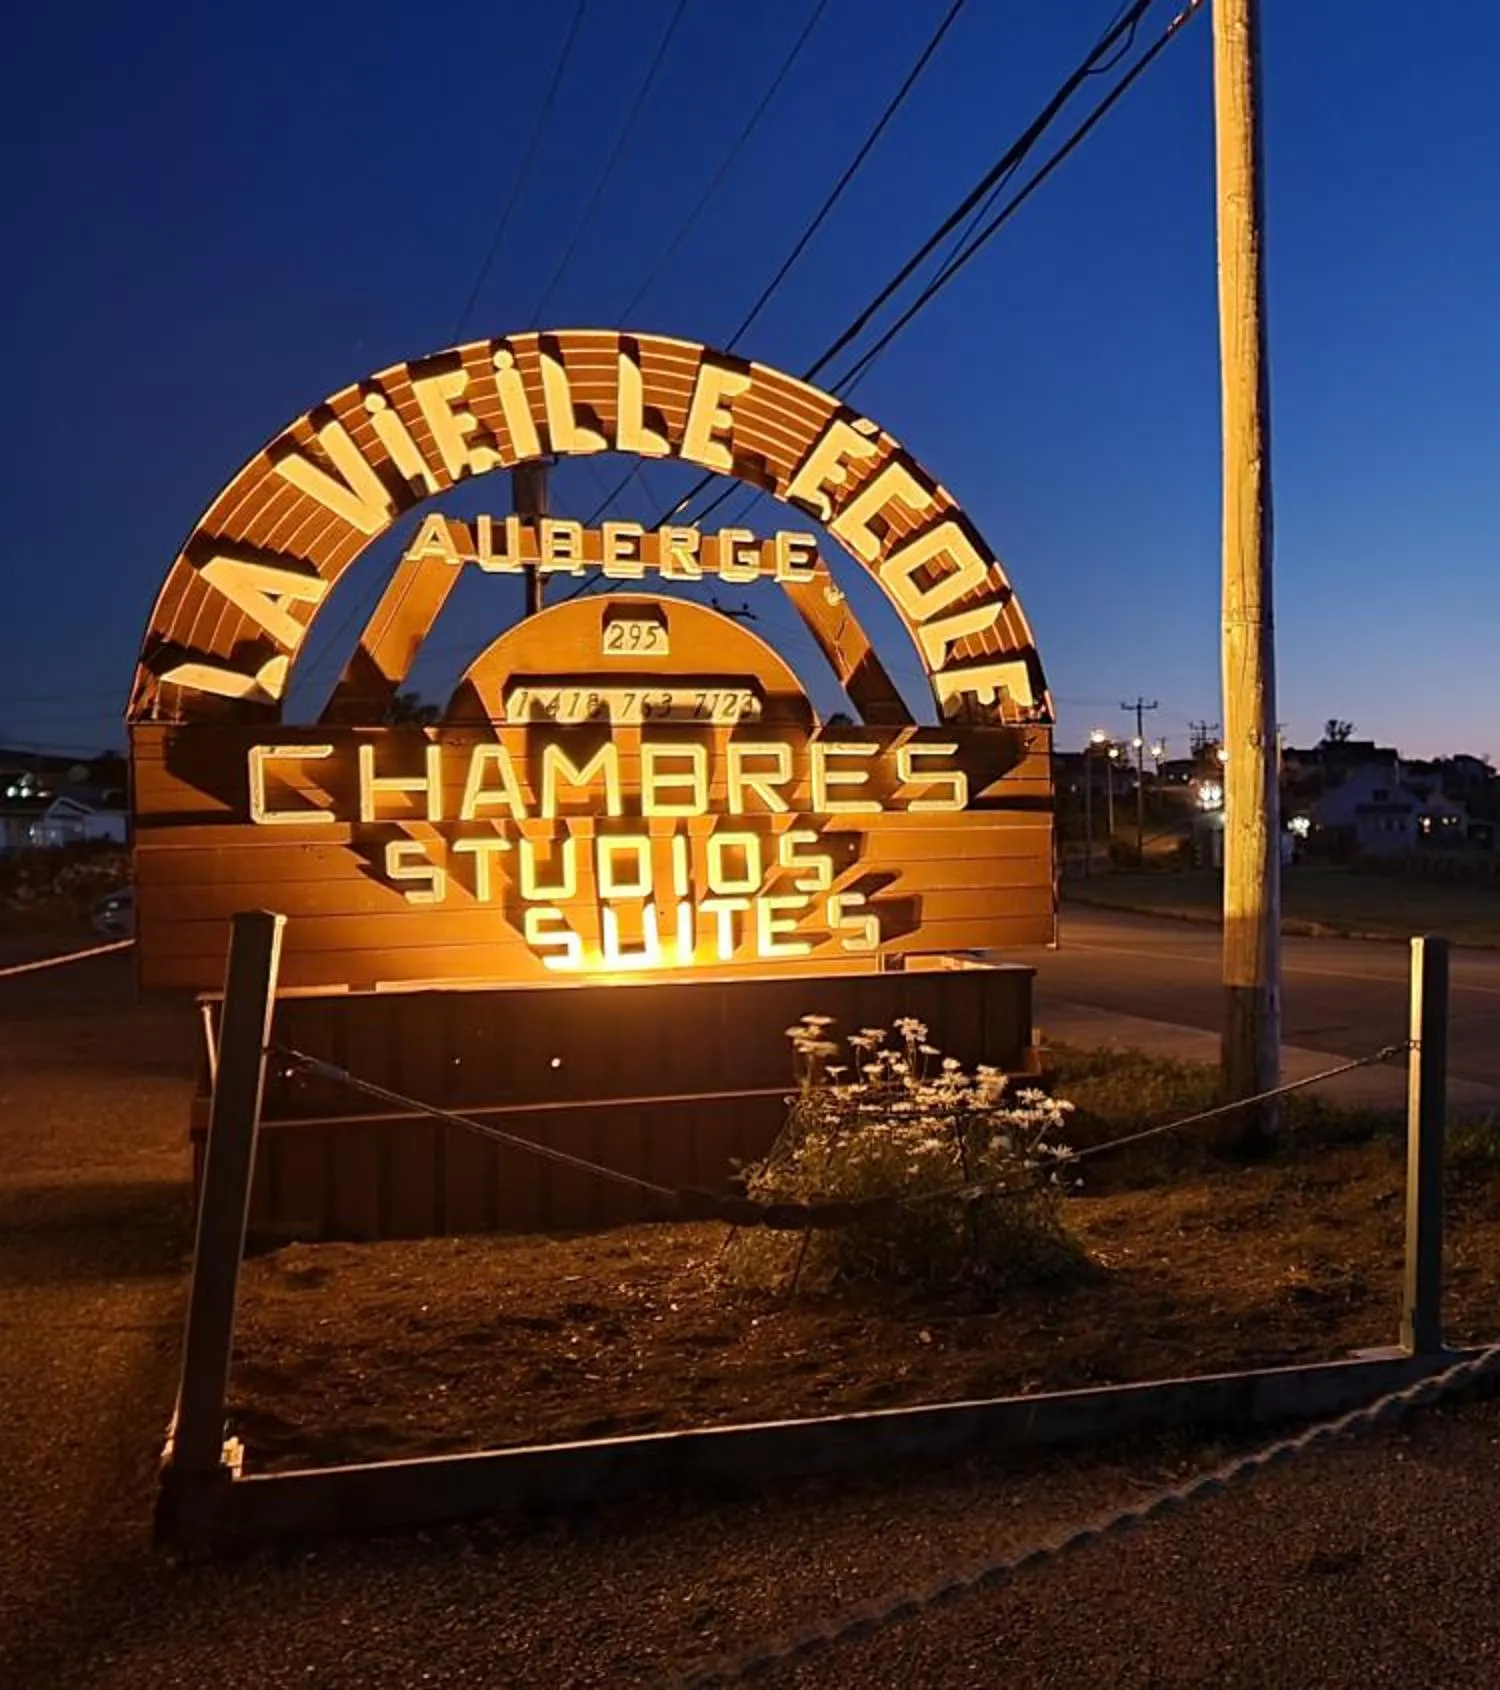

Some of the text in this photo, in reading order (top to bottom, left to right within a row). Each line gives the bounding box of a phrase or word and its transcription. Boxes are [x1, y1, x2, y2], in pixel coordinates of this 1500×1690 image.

[158, 555, 330, 701] LA
[785, 416, 1033, 716] ÉCOLE
[404, 513, 817, 584] AUBERGE
[606, 623, 659, 650] 295
[516, 691, 530, 717] 1
[543, 692, 602, 717] 418
[622, 692, 673, 718] 763
[247, 743, 969, 824] CHAMBRES
[384, 828, 833, 904] STUDIOS
[523, 892, 882, 971] SUITES
